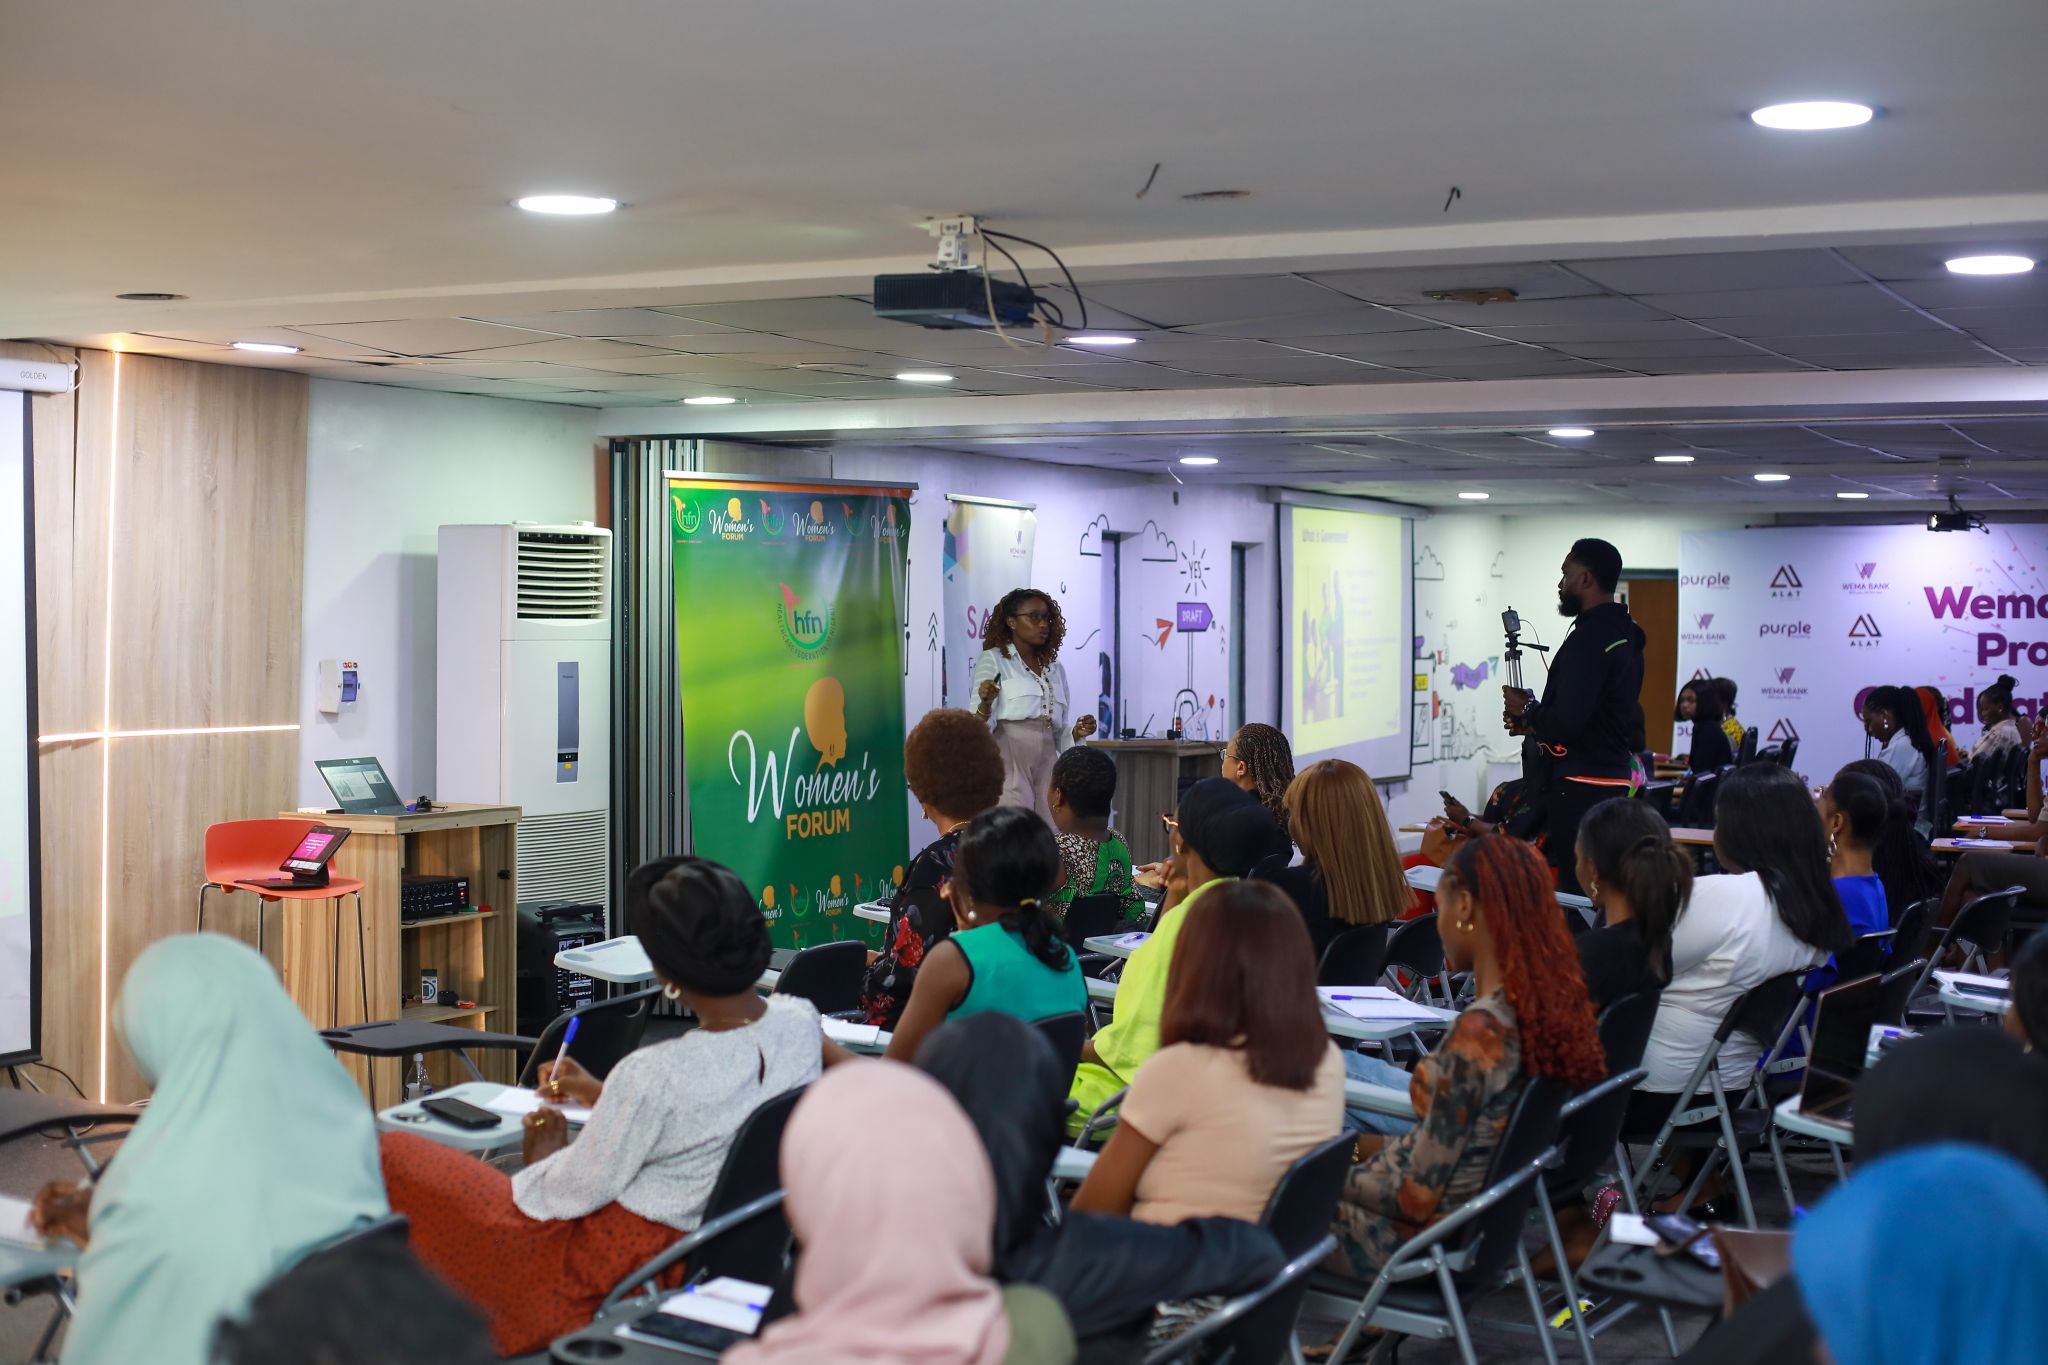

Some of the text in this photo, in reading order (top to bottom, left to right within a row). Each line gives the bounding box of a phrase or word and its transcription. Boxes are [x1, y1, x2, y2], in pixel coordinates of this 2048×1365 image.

[20, 370, 47, 380] GOLDEN
[682, 511, 697, 525] hfn
[708, 509, 755, 534] Women's
[792, 512, 836, 536] Women's
[721, 532, 744, 541] FORUM
[1188, 560, 1202, 580] YES
[1680, 571, 1731, 589] purple
[1772, 590, 1801, 598] ALAT
[793, 609, 823, 635] hfn
[1182, 609, 1203, 624] DRAFT
[1759, 620, 1812, 638] purple
[1977, 632, 2048, 667] Pro
[1761, 687, 1809, 695] WEMA BANK
[728, 726, 881, 824] Women's
[786, 807, 850, 840] FORUM
[815, 887, 849, 913] Women's
